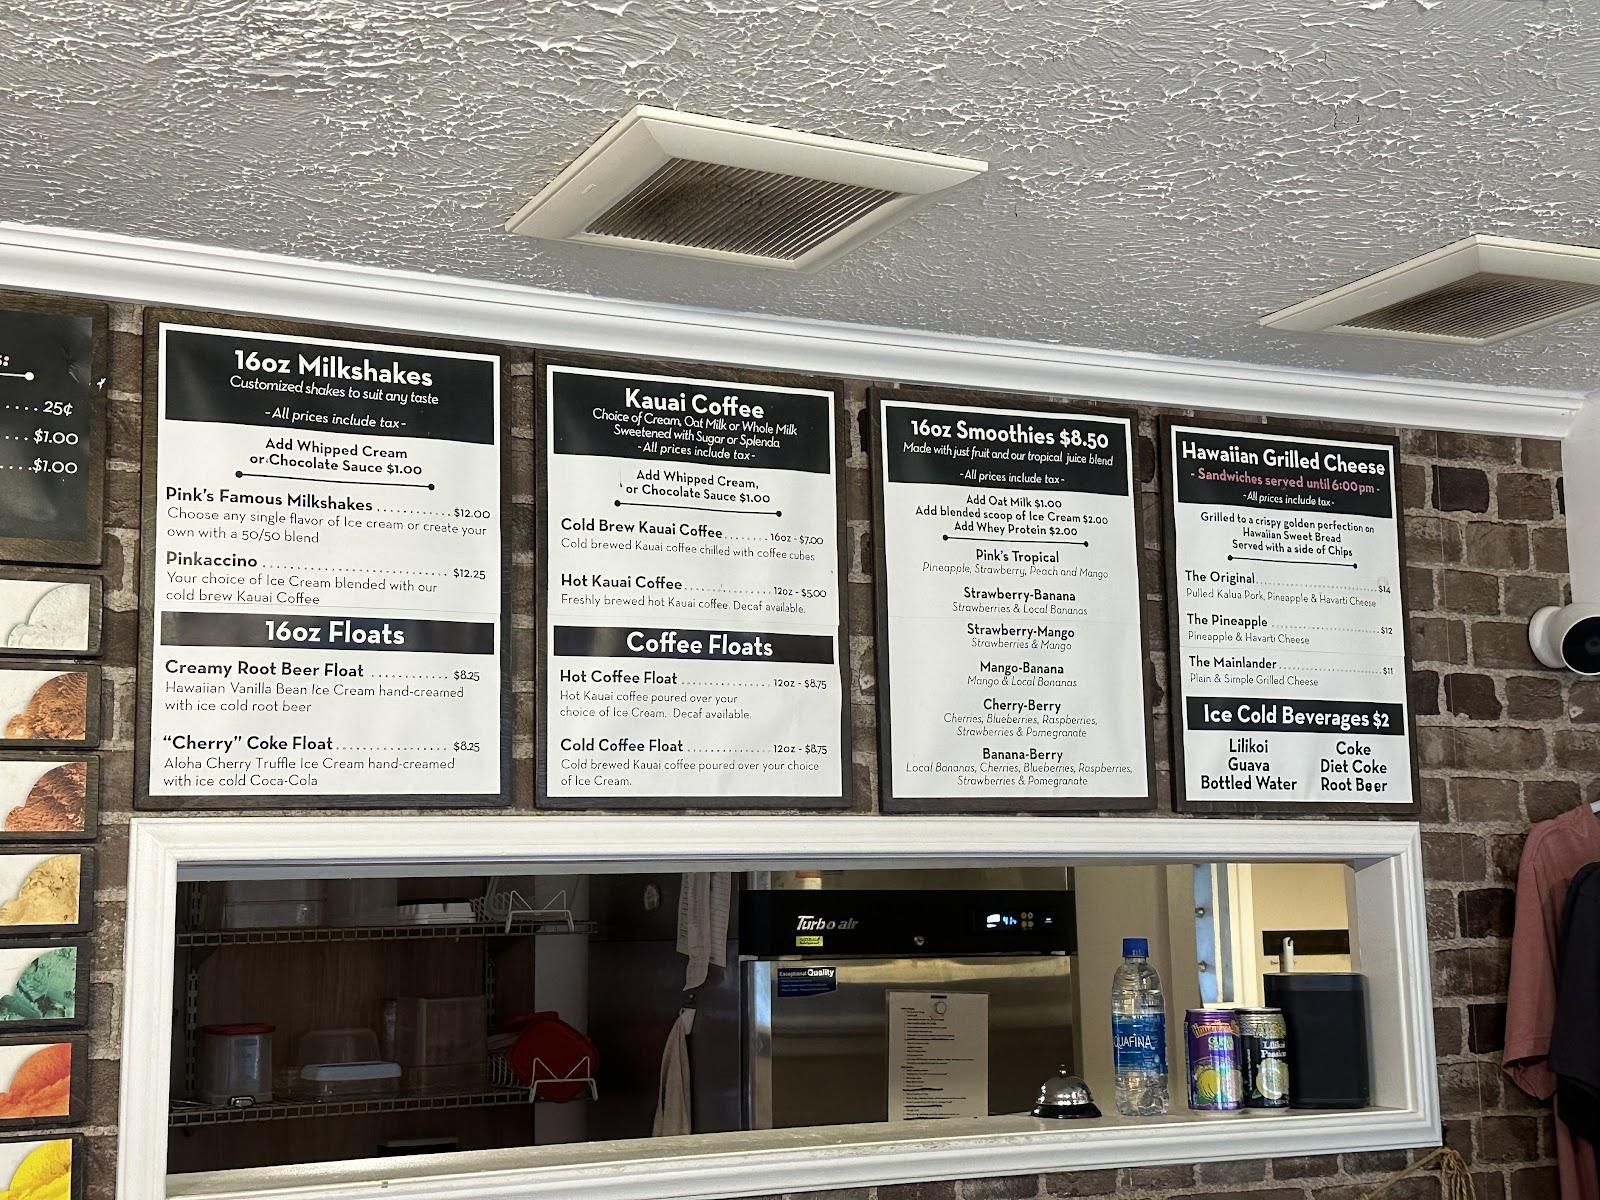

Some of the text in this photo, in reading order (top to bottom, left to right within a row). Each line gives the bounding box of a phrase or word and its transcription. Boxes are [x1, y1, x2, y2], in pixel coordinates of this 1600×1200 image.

[234, 349, 433, 387] 16oz Milkshakes
[42, 400, 73, 417] 25¢
[625, 387, 764, 419] Kauai Coffee
[291, 410, 328, 423] prices
[331, 413, 376, 427] include
[32, 427, 78, 445] $1.00
[613, 423, 780, 449] Sweetened with Sugar or Splenda
[910, 418, 1109, 450] 16oz Smoothies $8.50
[265, 437, 407, 459] Add Whipped Cream
[32, 457, 78, 474] $1.00
[249, 454, 422, 475] or Chocolate Sauce $1.00
[1182, 440, 1385, 475] Hawaiian Grilled Cheese
[636, 469, 759, 489] Add Whipped Cream,
[1198, 467, 1263, 485] Sandwiches
[1264, 475, 1304, 488] served
[1306, 477, 1330, 490] until
[1331, 479, 1375, 495] 6:00pm
[166, 486, 491, 519] Pink's Famous Milkshakes $12.00
[966, 494, 1062, 509] Add Oat Milk $1.00
[167, 526, 319, 543] own with a 50/50 blend
[560, 517, 595, 531] Cold
[599, 518, 635, 532] Brew
[639, 520, 676, 535] Kauai
[679, 523, 723, 539] Coffee
[770, 532, 791, 542] 16oz
[799, 534, 824, 545] $7.00
[954, 520, 1078, 536] Add Whey Protein $2.00
[1242, 526, 1341, 543] Hawaiian Sweet Bread
[976, 548, 1059, 565] Pink's Tropical
[1232, 538, 1263, 551] Served
[1265, 542, 1285, 553] with
[1294, 543, 1314, 554] side
[1316, 544, 1326, 555] of
[1327, 545, 1353, 559] Chips
[166, 550, 486, 580] Pinkaccino $12.25
[561, 573, 588, 587] Hot
[592, 574, 631, 588] Kauai
[635, 575, 682, 590] Coffee
[773, 586, 793, 596] 12oz
[801, 588, 827, 598] $5.00
[1184, 569, 1391, 594] The Original $14
[166, 588, 320, 605] cold brew Kauai Coffee
[963, 586, 1076, 603] Strawberry-Banana
[265, 619, 404, 645] 16oz Floats
[967, 622, 1075, 641] Strawberry-Mango
[1186, 612, 1392, 635] The Pineapple $12
[626, 630, 773, 656] Coffee Floats
[165, 659, 480, 682] Creamy Root Beer Float $8.25
[980, 660, 1064, 676] Mango-Banana
[1188, 654, 1393, 675] The Mainlander $11
[560, 669, 587, 683] Hot
[590, 669, 640, 684] Coffee
[643, 670, 678, 685] Float
[773, 678, 795, 688] 12oz
[804, 678, 827, 690] $8.75
[983, 697, 1061, 714] Cherry-Berry
[943, 712, 1097, 726] Cherries, Blueberries, Raspberries,
[1203, 703, 1390, 731] Ice Cold Beverages $2
[246, 735, 288, 750] Coke
[292, 735, 333, 750] Float
[453, 740, 480, 753] $8.25
[560, 737, 594, 751] Cold
[598, 737, 645, 752] Coffee
[649, 738, 683, 752] Float
[773, 744, 796, 753] 12oz
[804, 743, 827, 755] $8.75
[1229, 737, 1268, 753] Lilikoi
[1335, 740, 1371, 756] Coke
[982, 747, 1063, 763] Banana-Berry
[1228, 756, 1270, 772] Guava
[1320, 758, 1387, 774] Diet Coke
[163, 773, 317, 787] with ice cold Coca-Cola
[560, 774, 632, 786] of Ice Cream.
[1201, 774, 1297, 790] Bottled Water
[1320, 776, 1388, 793] Root Beer
[796, 915, 859, 930] Turbo air
[807, 968, 835, 978] Quality
